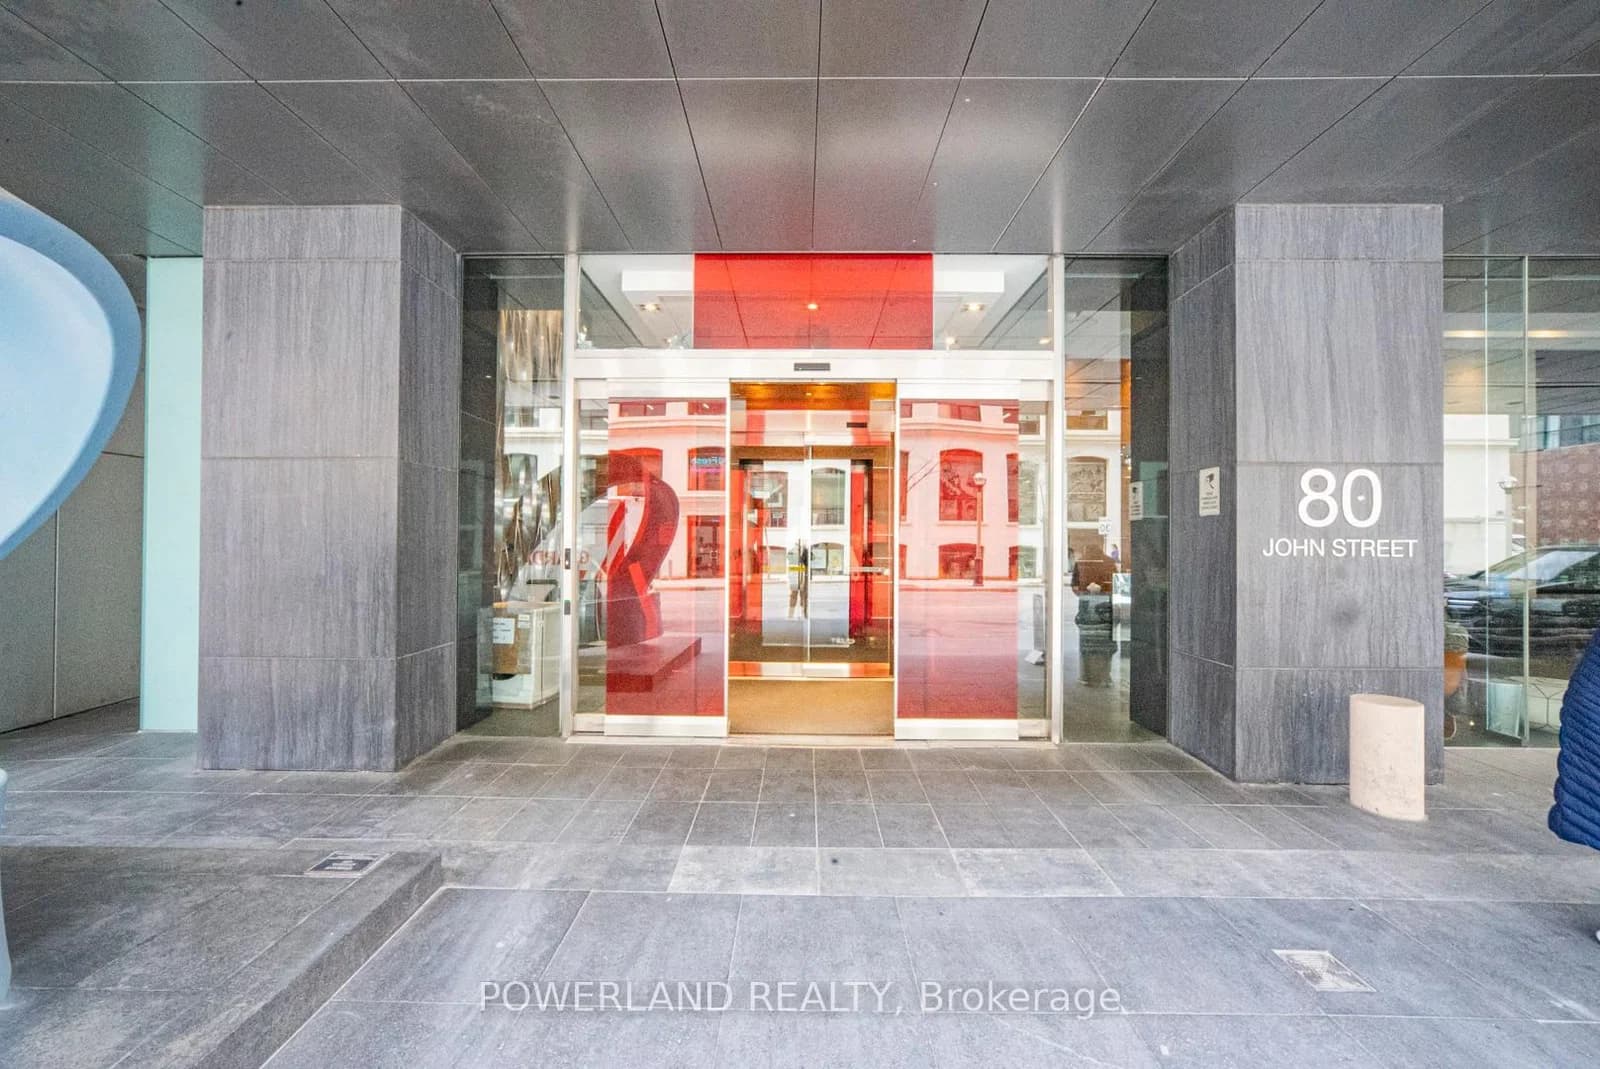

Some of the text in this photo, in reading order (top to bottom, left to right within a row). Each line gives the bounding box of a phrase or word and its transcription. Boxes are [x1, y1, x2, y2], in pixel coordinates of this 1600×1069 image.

[1298, 467, 1383, 528] 80
[1262, 537, 1419, 558] JOHN STREET
